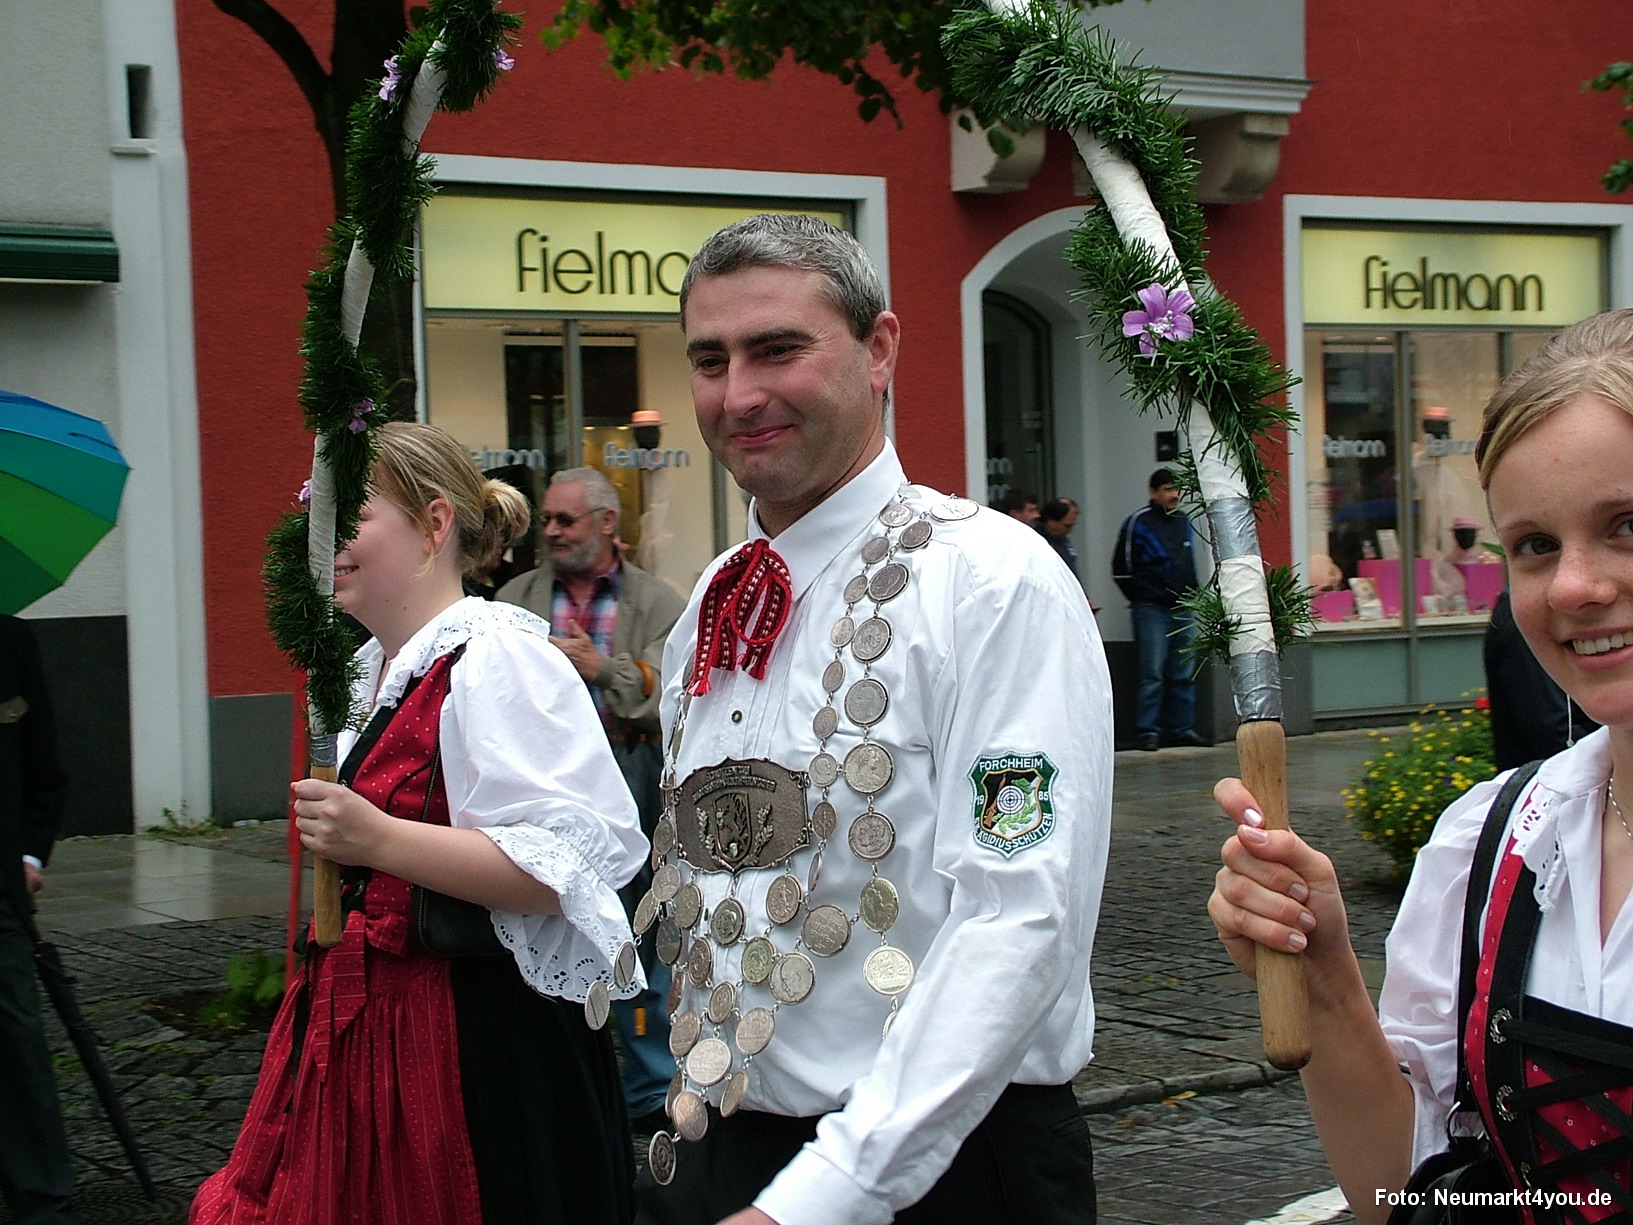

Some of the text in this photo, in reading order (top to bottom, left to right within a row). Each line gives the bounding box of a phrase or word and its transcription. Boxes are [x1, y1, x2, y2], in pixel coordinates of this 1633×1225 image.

[516, 228, 690, 296] fielma
[1364, 255, 1544, 311] fielmann
[980, 758, 1043, 773] FORCHHEIM
[1038, 791, 1049, 801] 85
